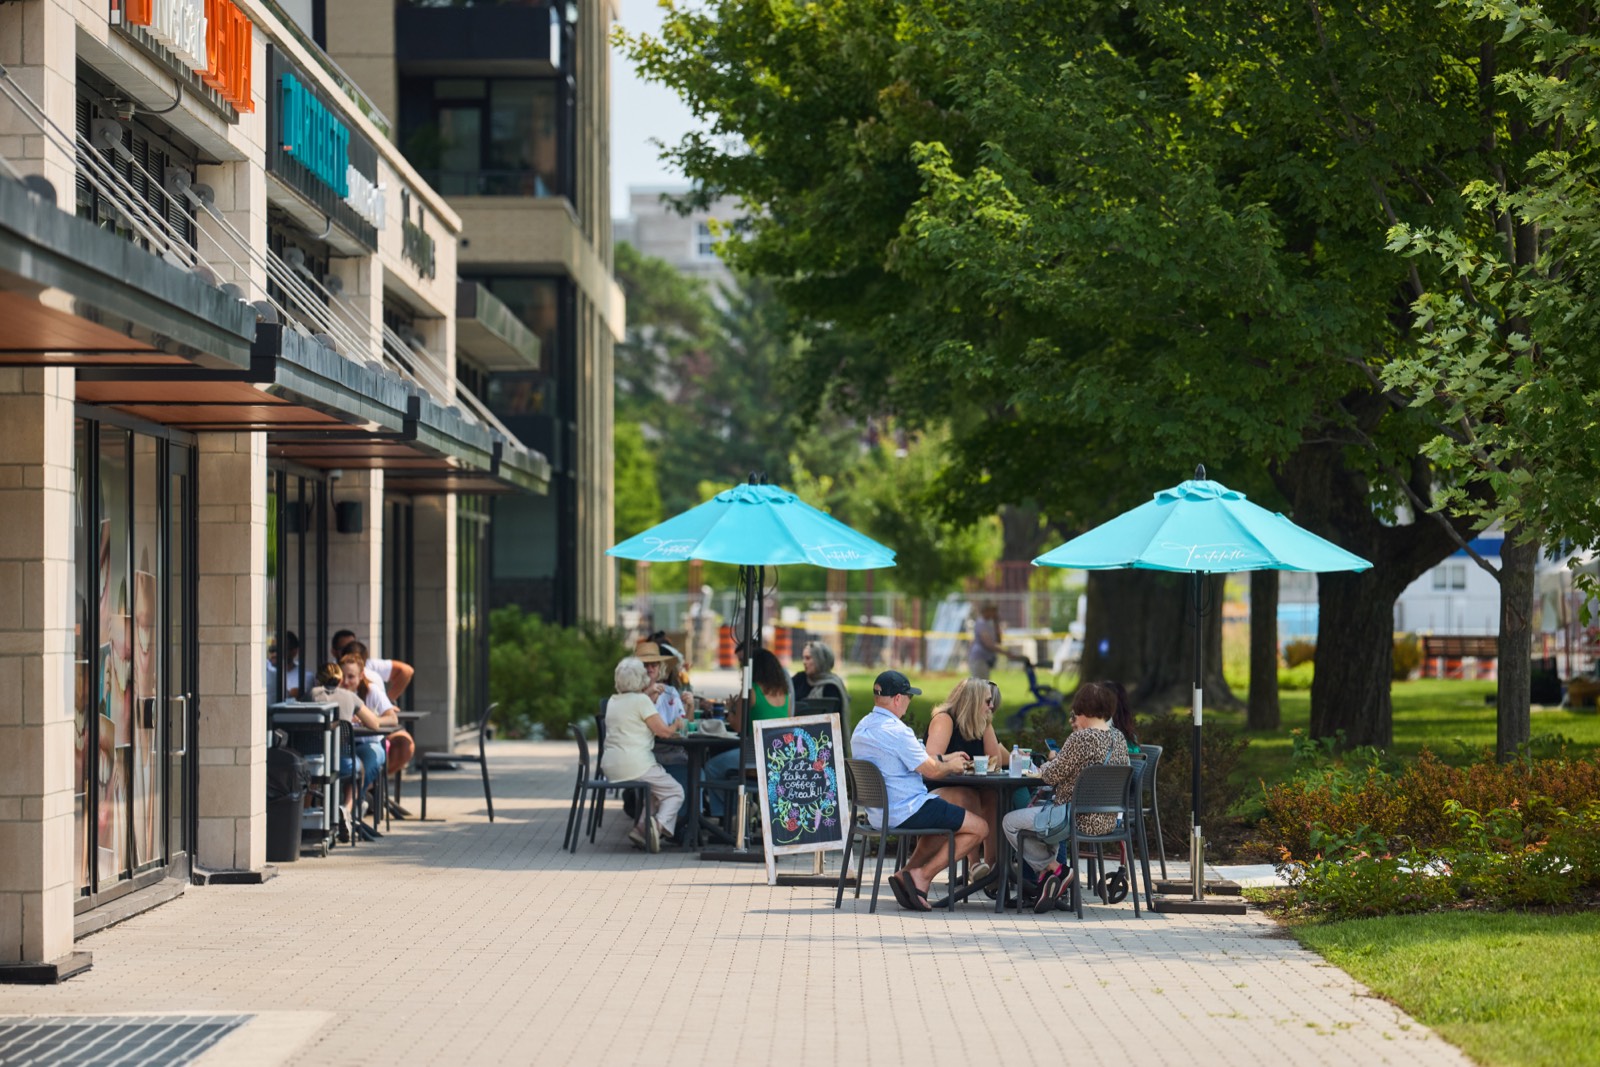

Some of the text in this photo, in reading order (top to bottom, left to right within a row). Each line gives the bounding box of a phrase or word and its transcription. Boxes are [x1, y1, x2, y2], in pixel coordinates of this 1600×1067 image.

[282, 73, 350, 198] TARTELETTE
[782, 771, 808, 781] take
[785, 781, 815, 789] coffee
